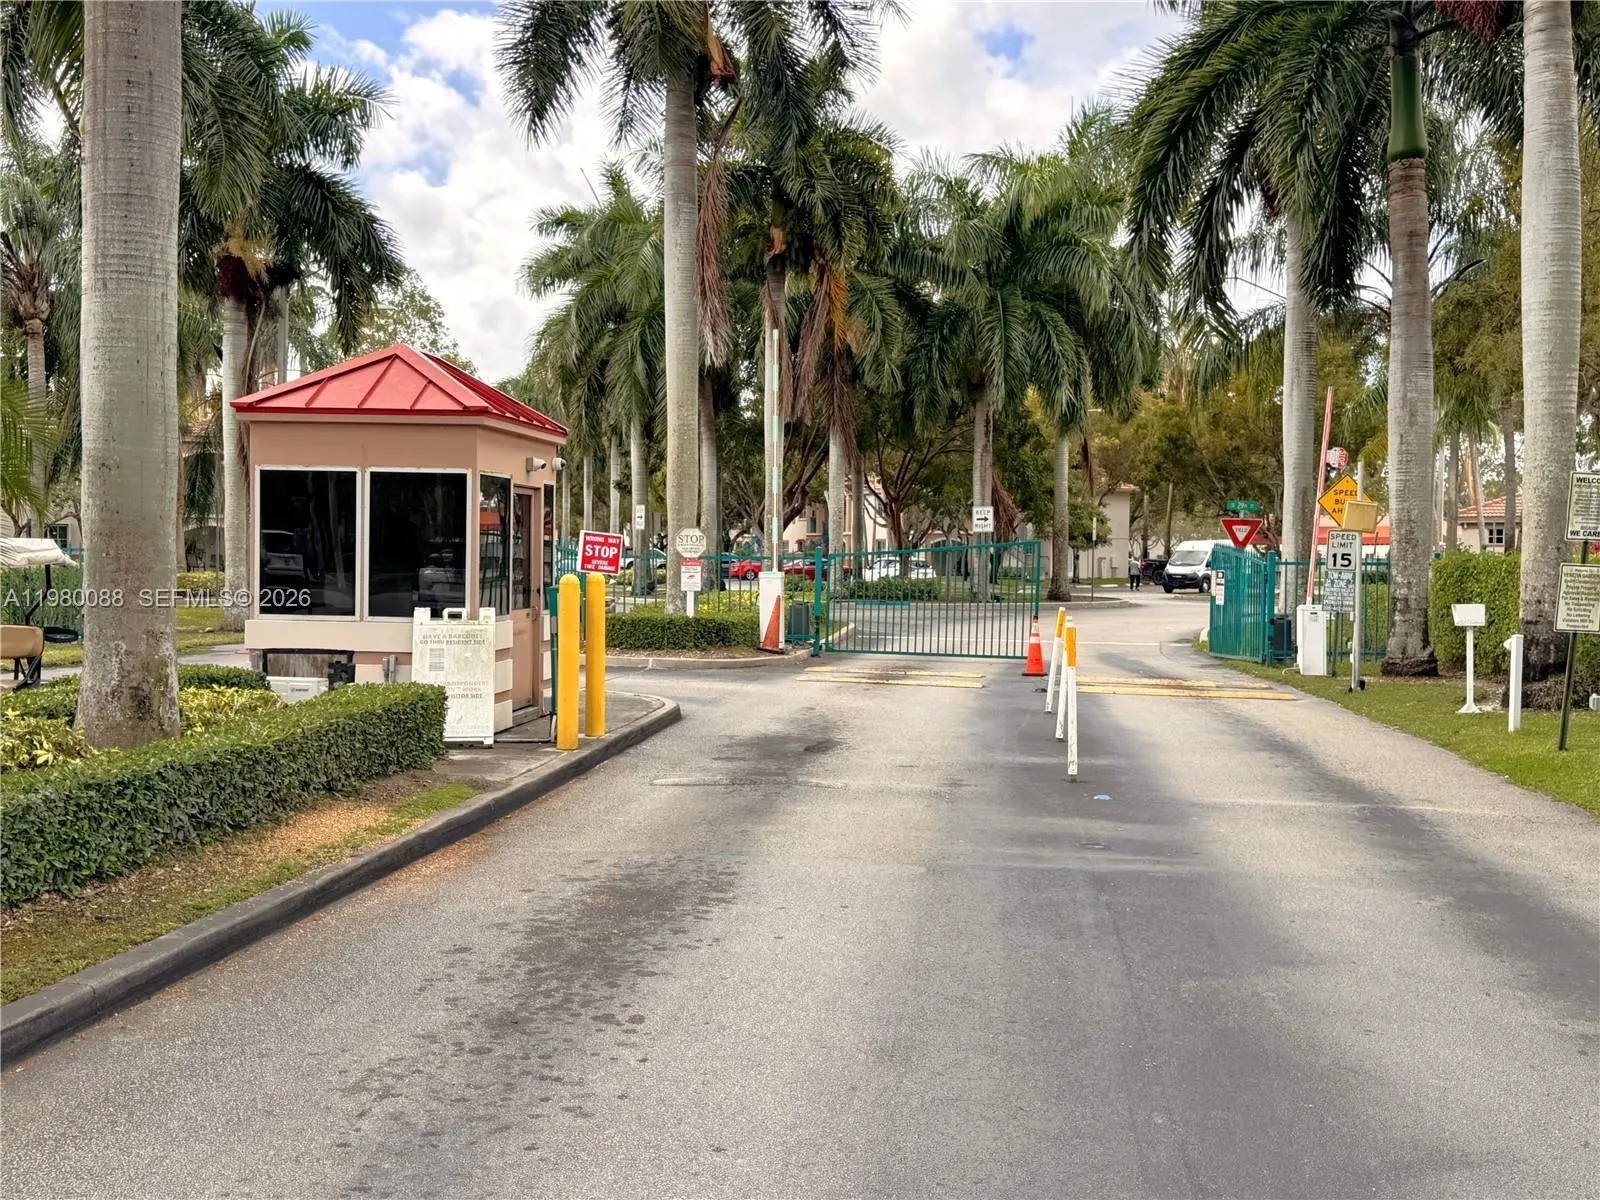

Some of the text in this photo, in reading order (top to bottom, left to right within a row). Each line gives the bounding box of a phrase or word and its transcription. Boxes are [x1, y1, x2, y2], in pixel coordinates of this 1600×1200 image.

[585, 535, 620, 545] WRONG WAY
[678, 534, 705, 543] STOP
[1330, 533, 1357, 541] SPEED
[1331, 541, 1353, 549] LIMIT
[585, 544, 618, 558] STOP
[1331, 552, 1352, 568] 15
